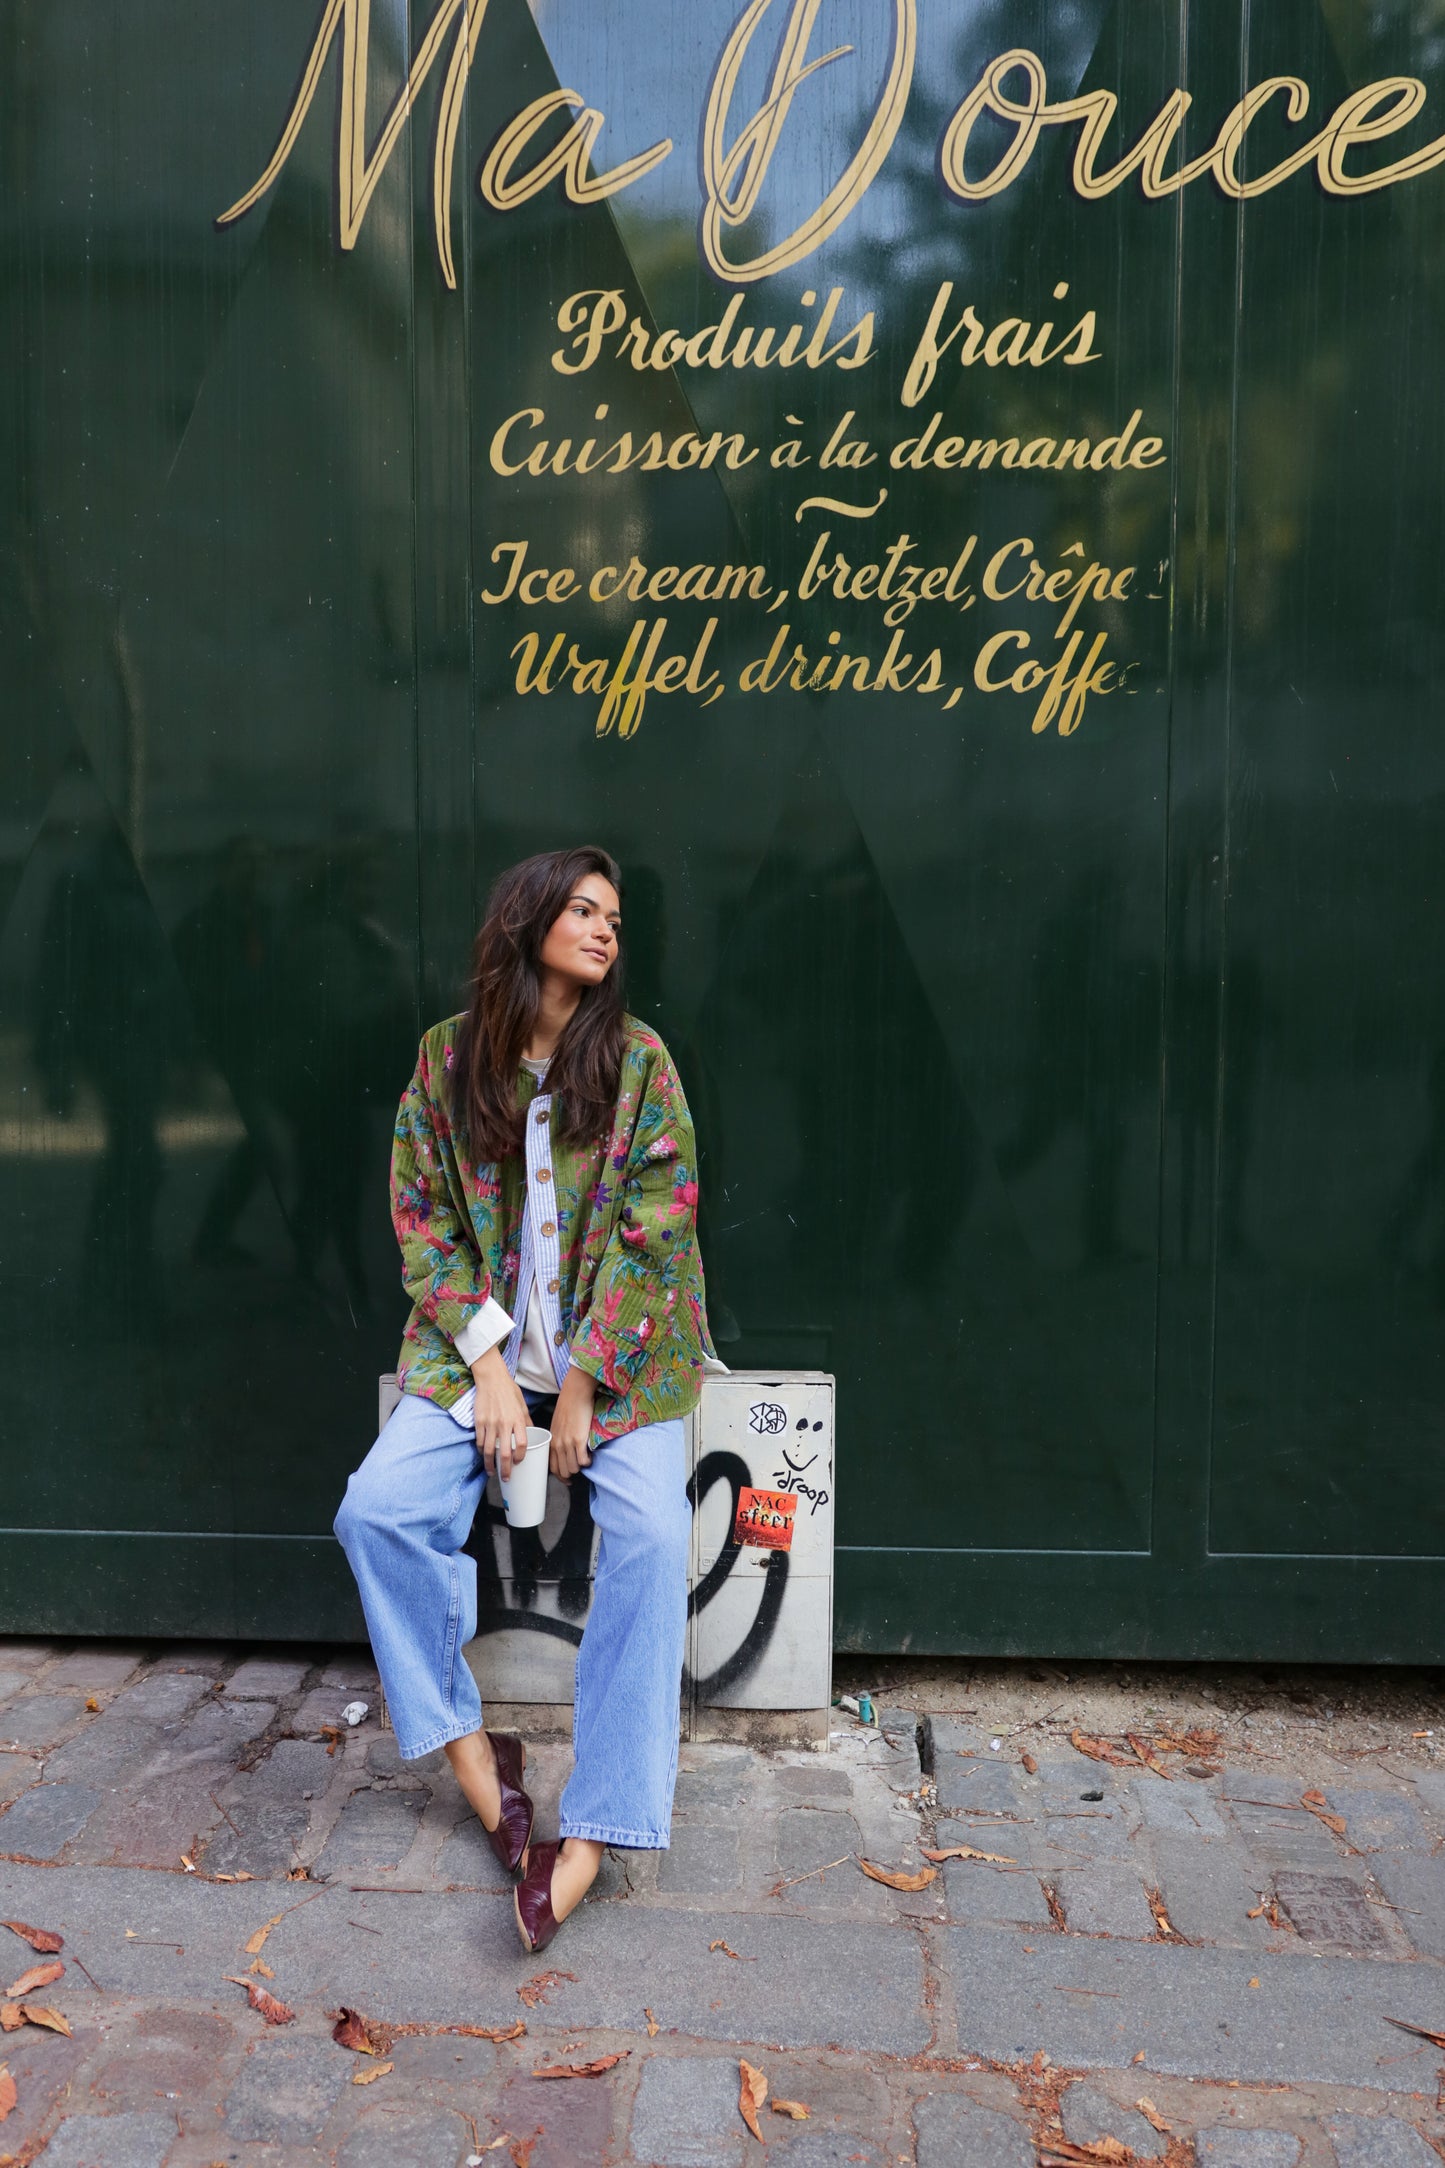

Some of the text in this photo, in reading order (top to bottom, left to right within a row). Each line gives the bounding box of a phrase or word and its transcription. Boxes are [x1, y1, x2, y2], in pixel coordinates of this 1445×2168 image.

[215, 0, 1445, 290] Ma Douce
[901, 281, 1102, 407] frais
[489, 403, 1168, 476] Cuisson à la demande
[480, 530, 1170, 639] Ice cream, bretzel, Crêpe
[510, 617, 725, 741] Waffel,
[738, 624, 964, 710] drinks,
[749, 1494, 787, 1511] NAC
